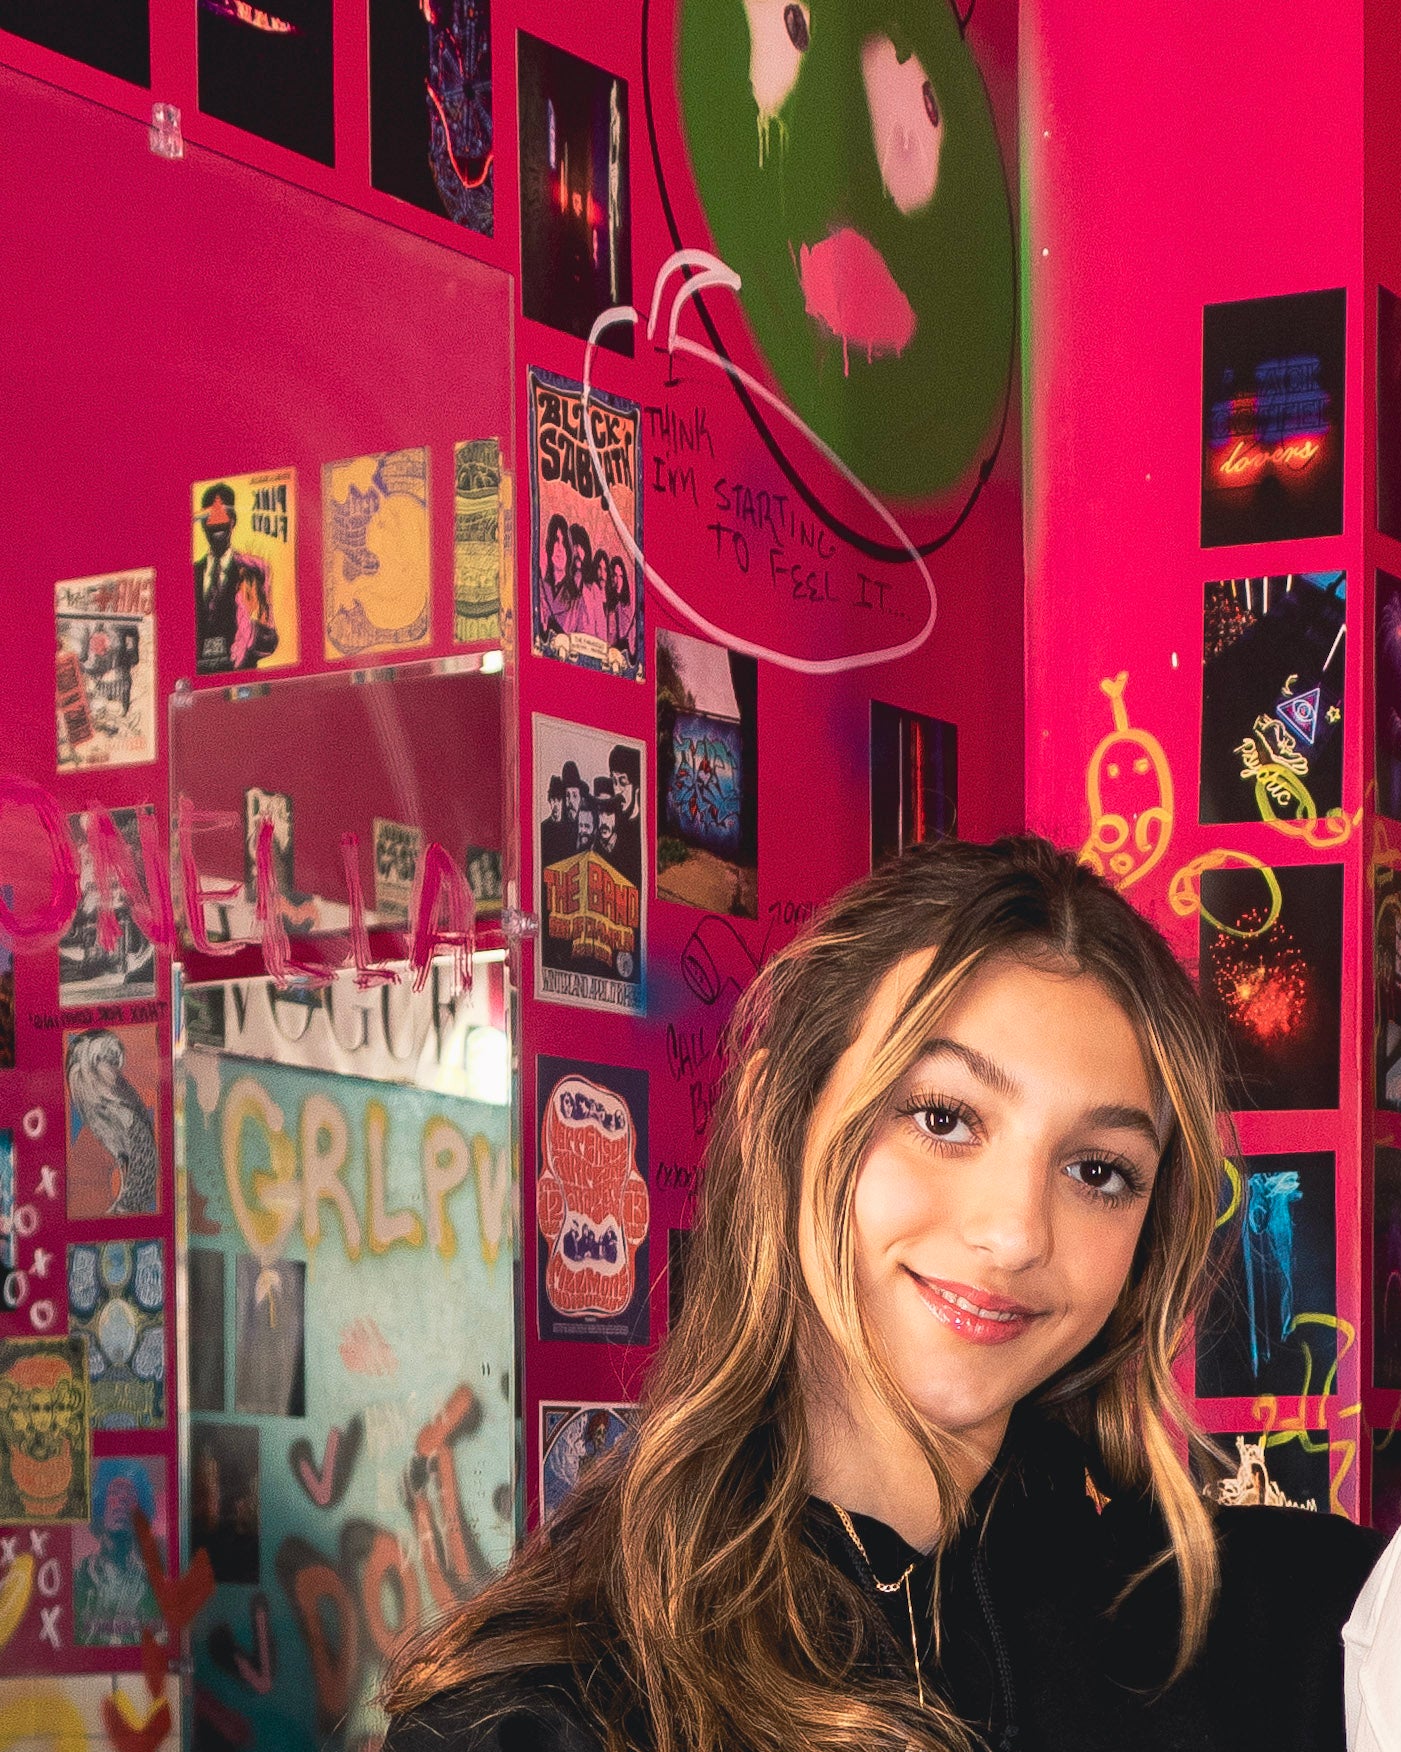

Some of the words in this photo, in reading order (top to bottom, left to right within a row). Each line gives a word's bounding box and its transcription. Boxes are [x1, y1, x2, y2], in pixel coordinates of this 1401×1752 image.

[644, 404, 715, 460] THINK
[1219, 440, 1320, 474] lovers
[713, 477, 837, 559] STARTING
[706, 521, 750, 574] TO
[768, 548, 839, 602] FEEL
[543, 861, 580, 914] THE
[587, 860, 639, 929] BAND
